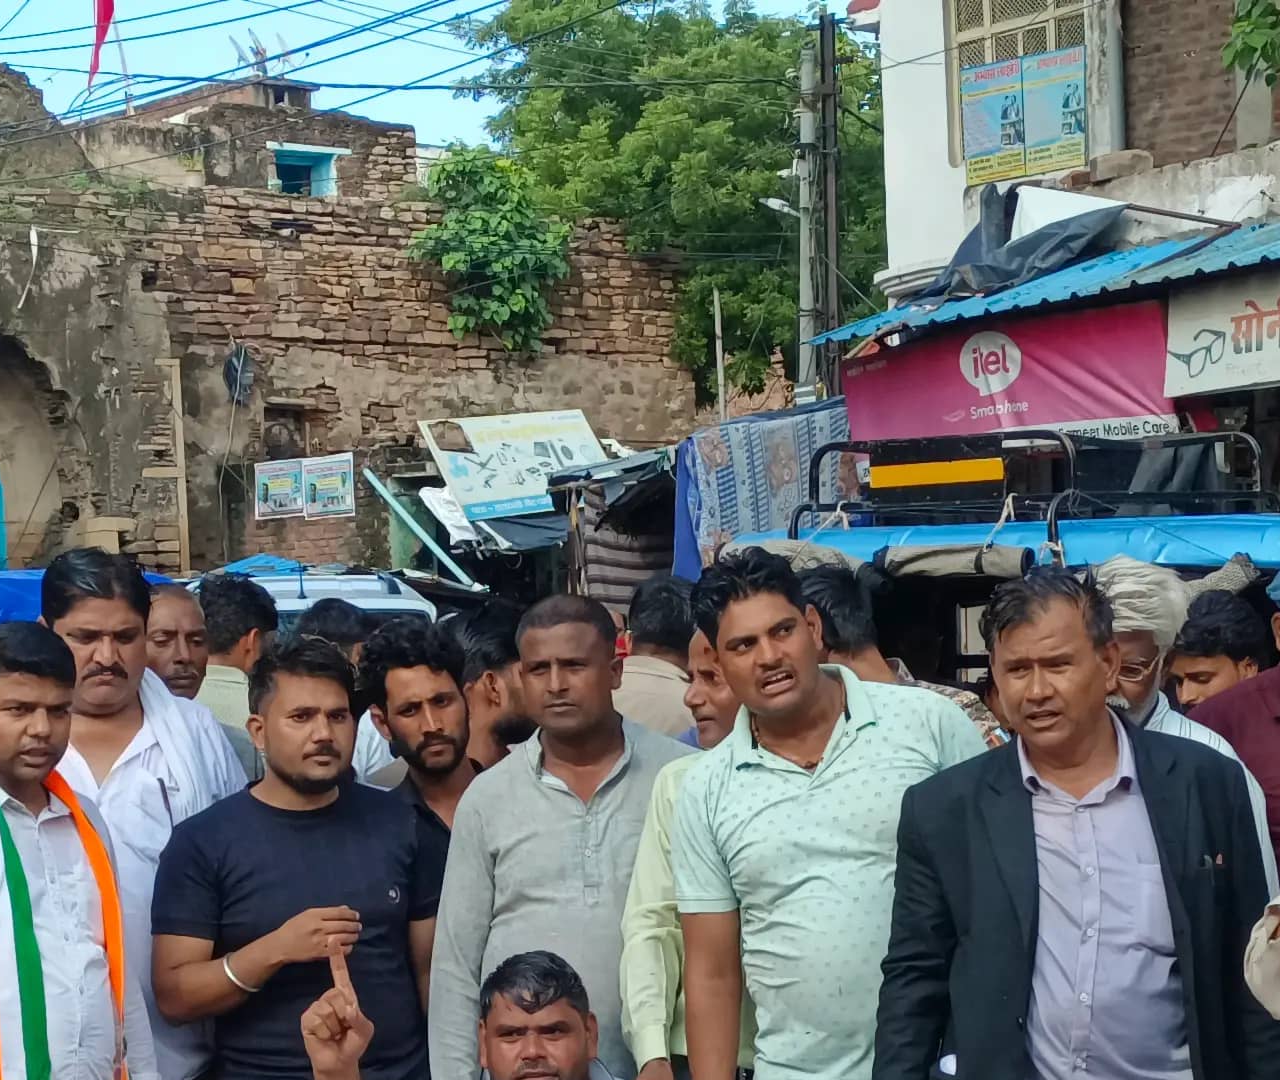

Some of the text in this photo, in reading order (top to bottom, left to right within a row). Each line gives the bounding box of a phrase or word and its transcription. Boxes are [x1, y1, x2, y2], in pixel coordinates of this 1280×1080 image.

[971, 343, 1010, 379] itel
[1103, 422, 1140, 437] Mobile
[1142, 420, 1170, 435] Care
